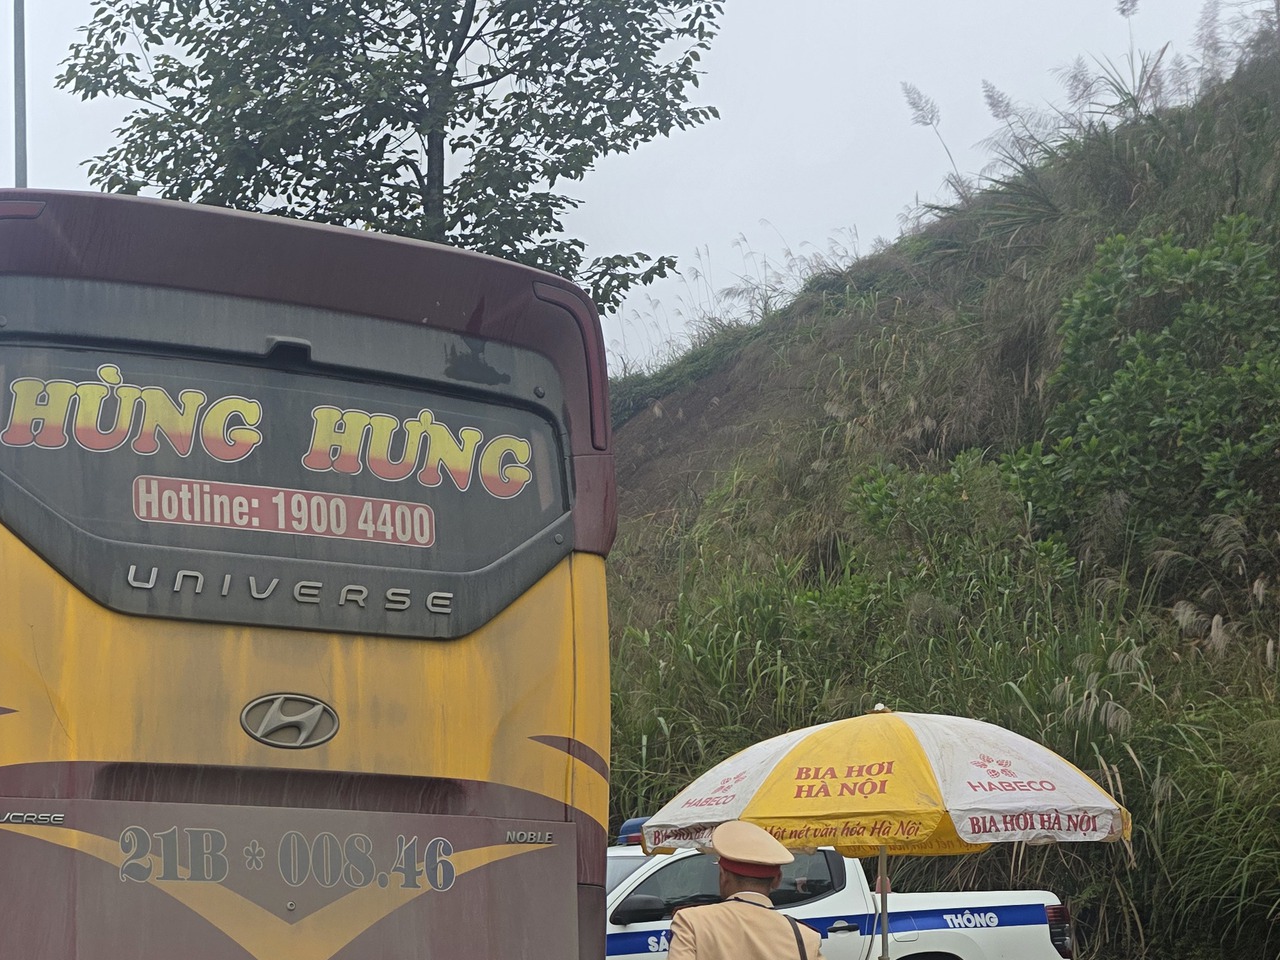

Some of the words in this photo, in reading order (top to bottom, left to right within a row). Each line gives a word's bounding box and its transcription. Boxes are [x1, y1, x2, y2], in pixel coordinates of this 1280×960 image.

[301, 404, 533, 500] HƯNG
[137, 478, 260, 527] Hotline:
[271, 491, 347, 535] 1900
[357, 501, 431, 544] 4400
[127, 564, 454, 614] UNIVERSE
[795, 766, 838, 780] BIA
[844, 760, 895, 778] HƠI
[793, 780, 832, 799] HÀ
[837, 777, 888, 799] NỘI
[967, 780, 1057, 793] HABECO
[680, 794, 737, 809] HABECO
[788, 823, 811, 840] nét
[813, 822, 838, 838] văn
[840, 820, 867, 837] hóa
[869, 819, 893, 837] Hà
[894, 819, 923, 840] Nội
[968, 815, 1001, 835] BIA
[1001, 812, 1037, 832] HƠI
[1037, 808, 1063, 832] HÀ
[1065, 809, 1099, 837] NỘI
[505, 830, 553, 844] NOBLE
[119, 825, 229, 883] 21B
[277, 830, 456, 892] 008.46
[647, 930, 670, 952] SÁ
[942, 909, 999, 928] THÔNG
